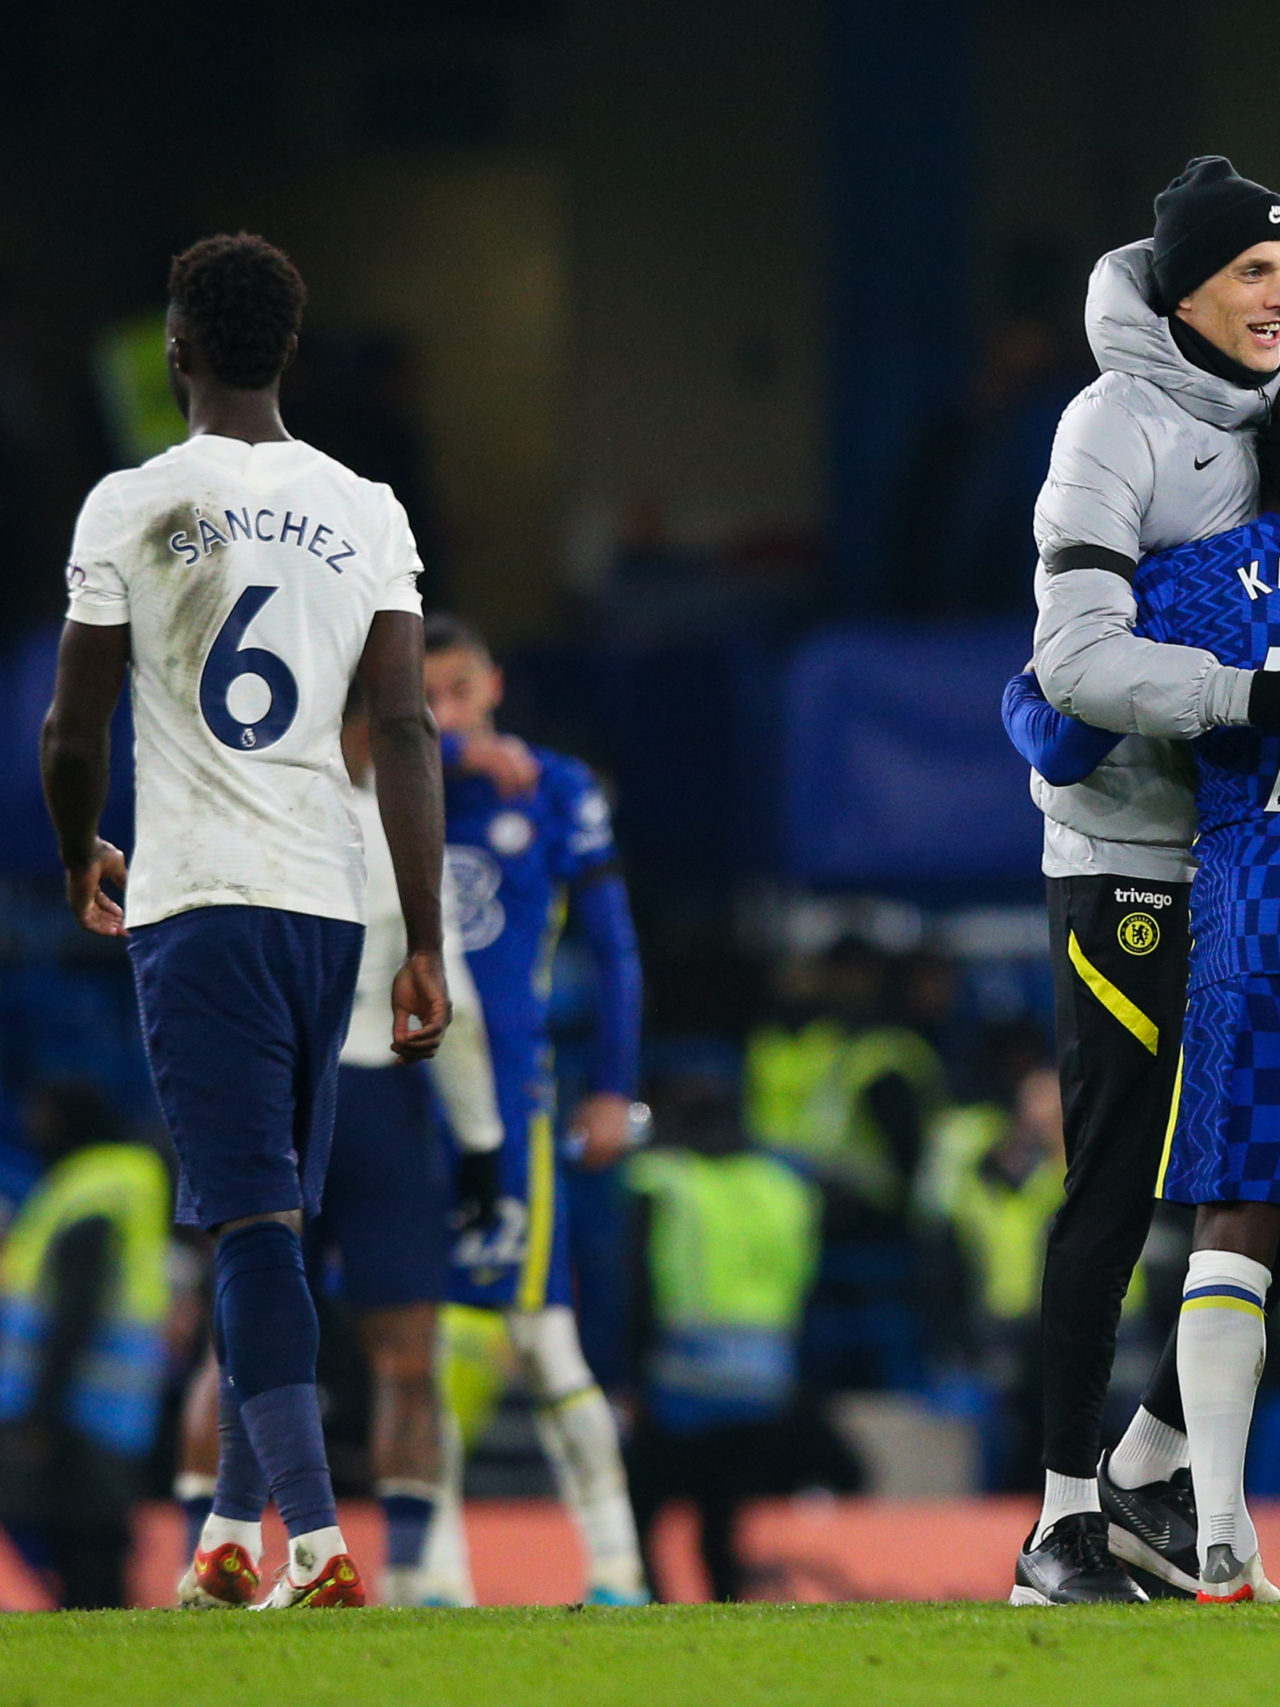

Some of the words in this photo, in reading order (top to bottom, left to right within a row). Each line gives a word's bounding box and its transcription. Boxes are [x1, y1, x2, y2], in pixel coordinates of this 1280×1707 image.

[170, 507, 358, 575] SÁNCHEZ
[200, 586, 299, 751] 6
[1113, 887, 1173, 909] trivago
